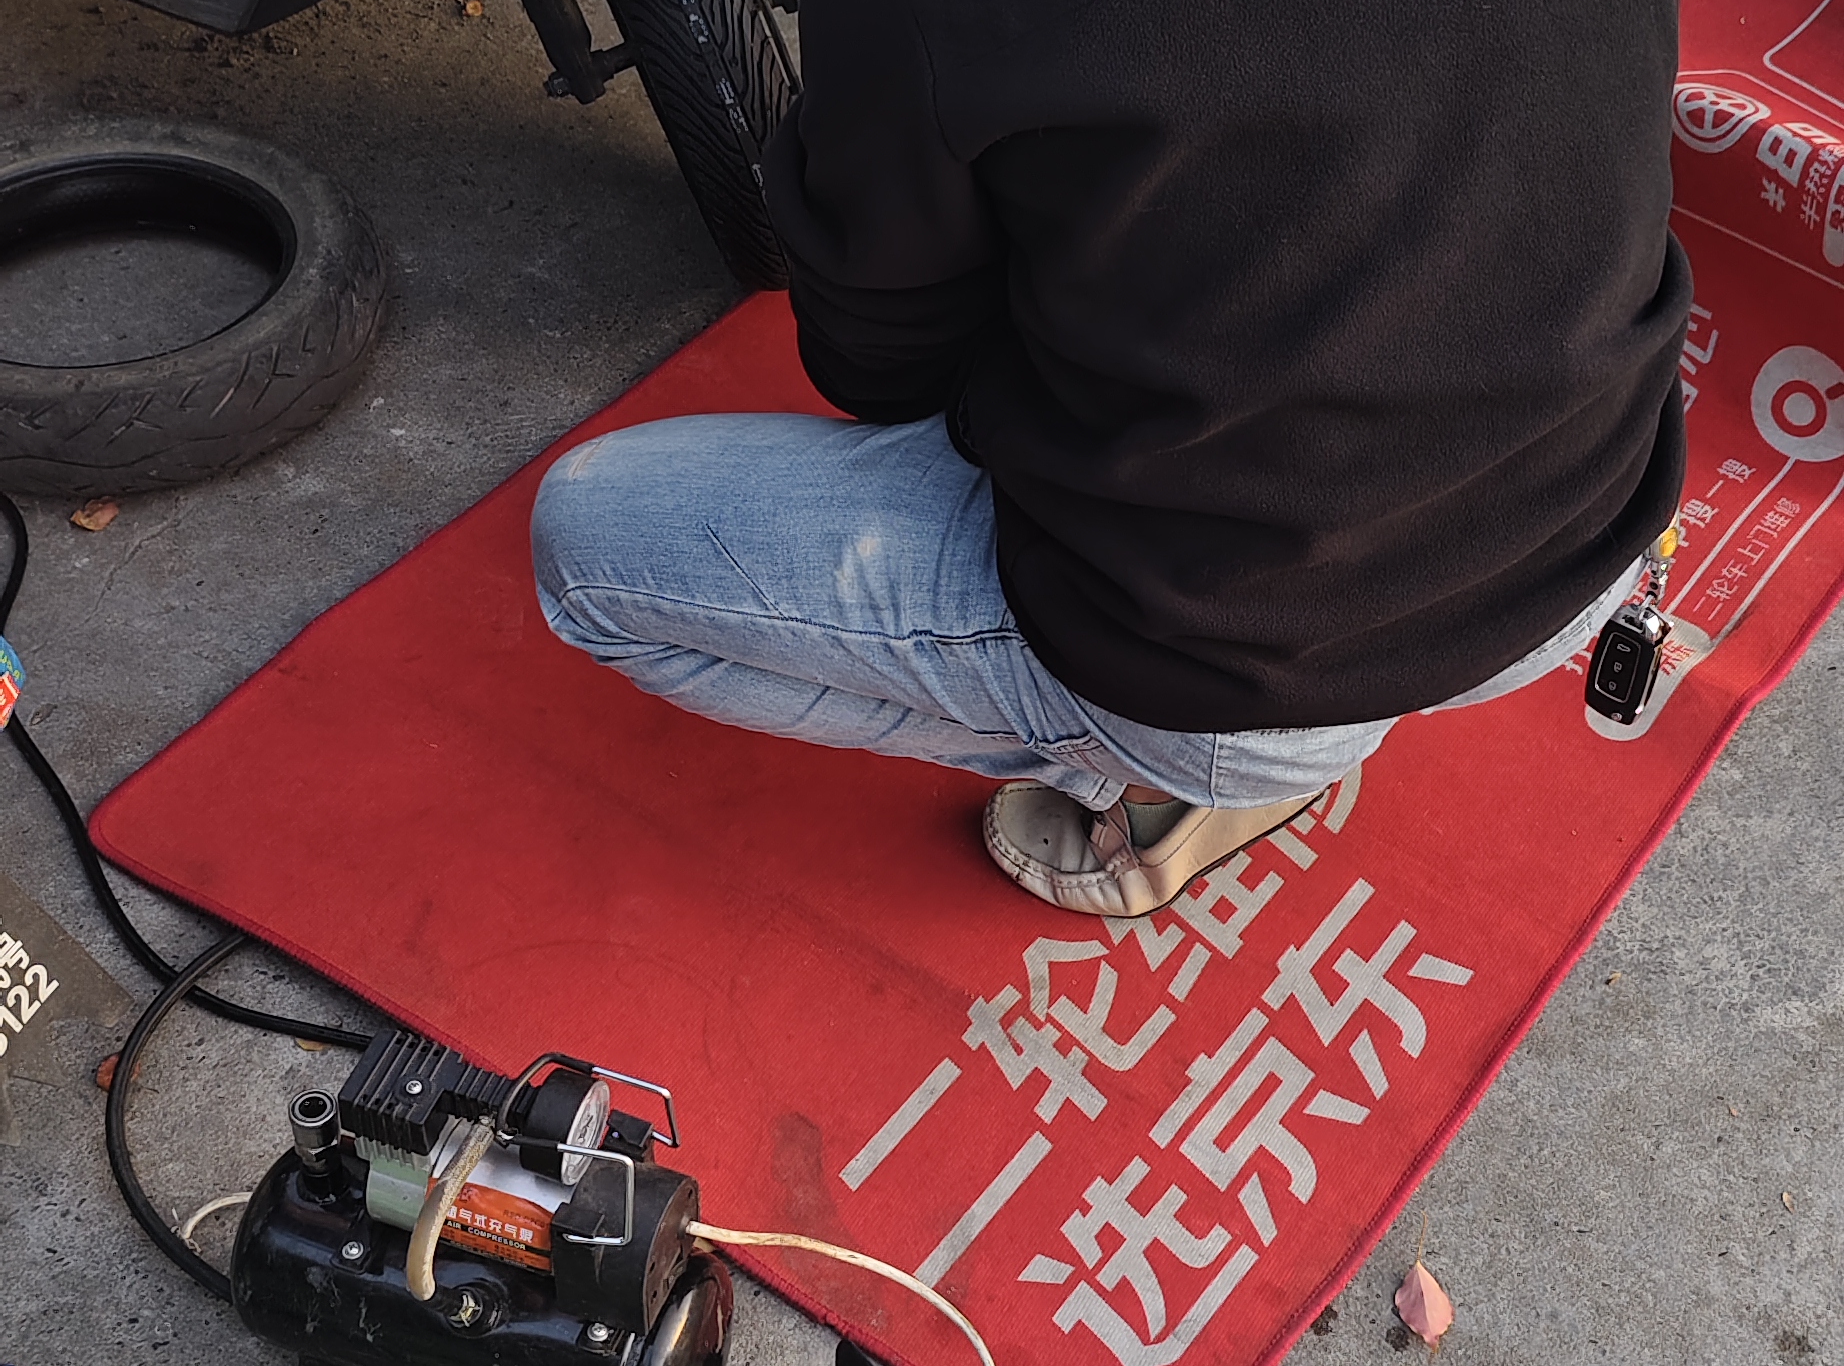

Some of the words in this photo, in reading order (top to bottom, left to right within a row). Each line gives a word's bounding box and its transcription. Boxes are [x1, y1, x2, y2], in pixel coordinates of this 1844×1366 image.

[1693, 497, 1801, 621] 二轮车上门维修
[447, 1220, 462, 1230] AIR
[468, 1227, 526, 1251] COMPRESSOR
